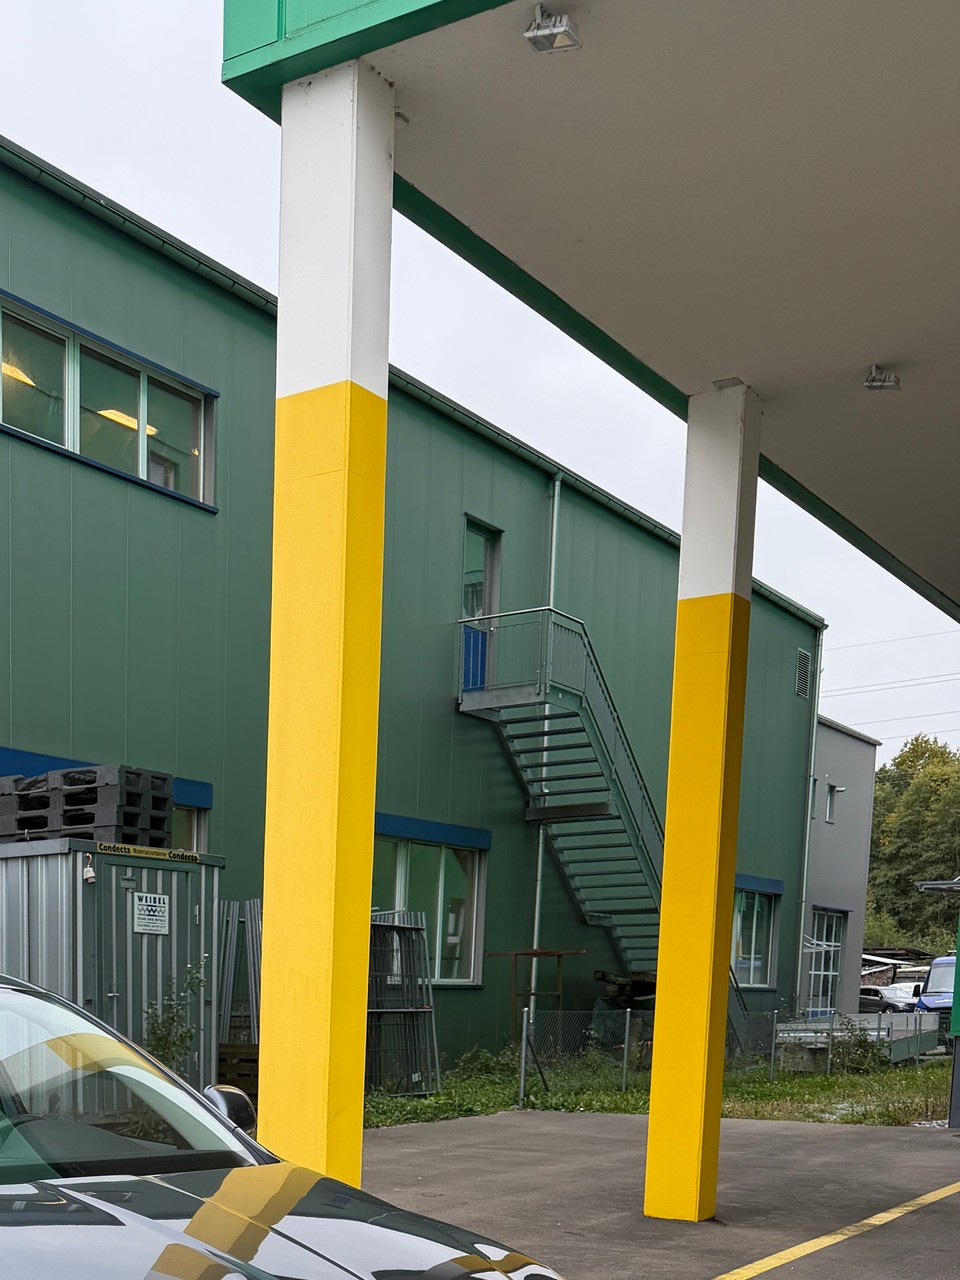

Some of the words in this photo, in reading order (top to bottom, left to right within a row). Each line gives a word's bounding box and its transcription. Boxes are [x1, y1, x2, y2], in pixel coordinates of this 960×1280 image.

[99, 843, 131, 854] Condecta
[168, 851, 198, 862] Condecta
[137, 895, 166, 905] WEIBEL
